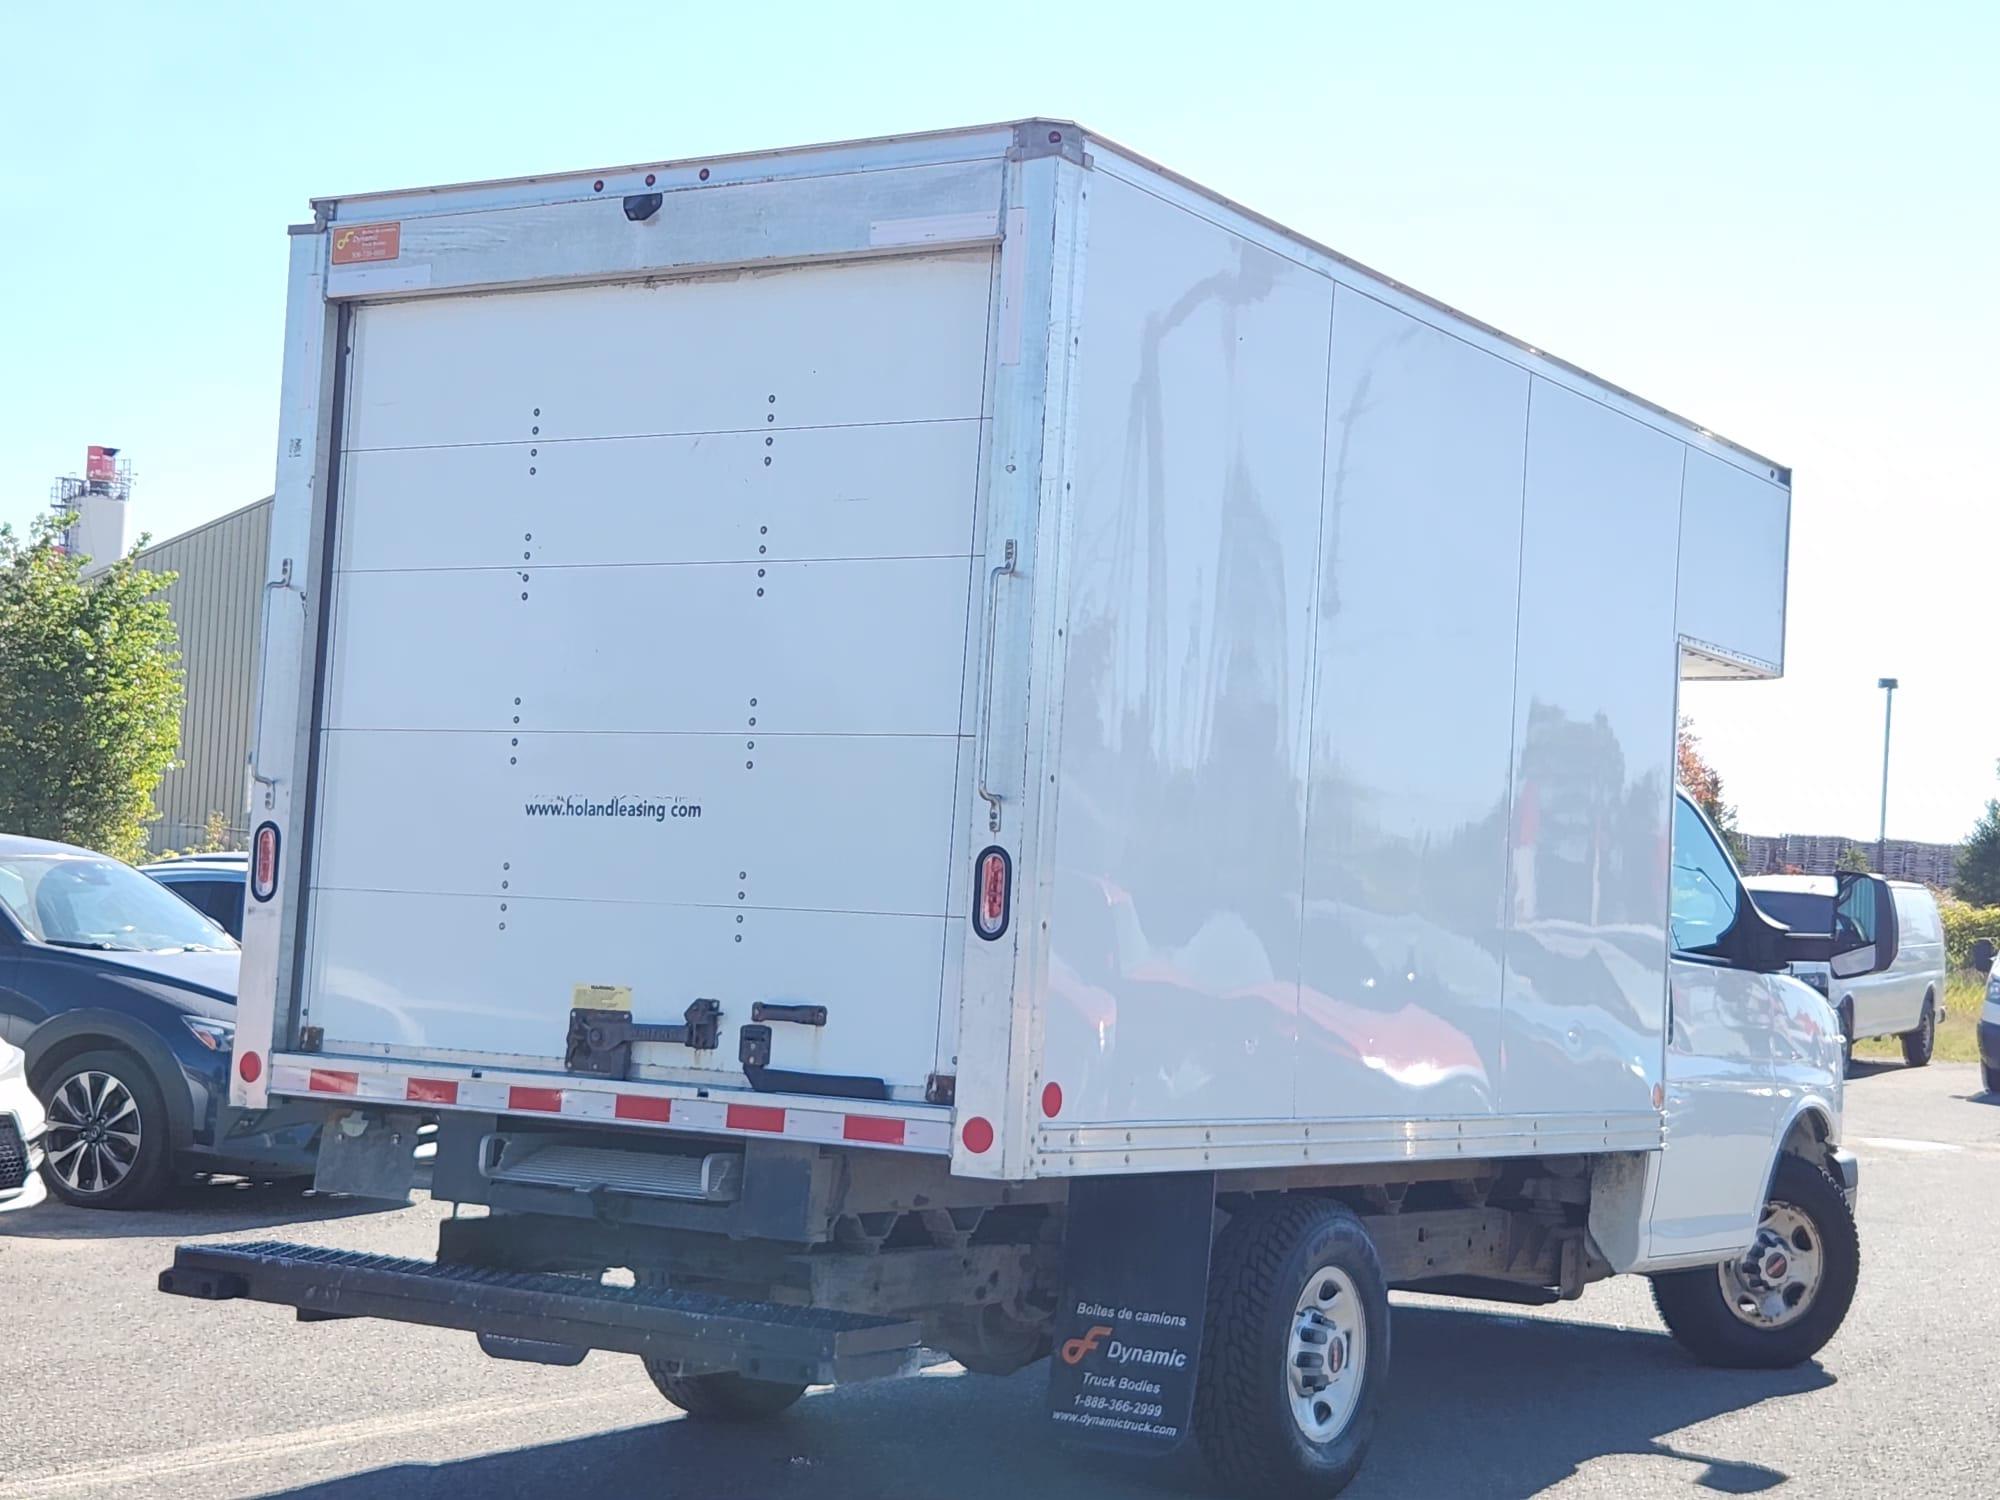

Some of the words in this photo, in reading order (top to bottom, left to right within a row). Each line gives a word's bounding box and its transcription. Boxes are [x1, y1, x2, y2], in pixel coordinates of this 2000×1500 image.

[1117, 1307, 1133, 1320] de
[1135, 1311, 1187, 1327] camions
[1107, 1341, 1187, 1367] Dynamic
[1083, 1372, 1117, 1388] Truck
[1118, 1378, 1161, 1394] Bodies
[1074, 1394, 1162, 1417] 1-888-366-2999
[1052, 1410, 1177, 1436] www.dynamictruck.com
